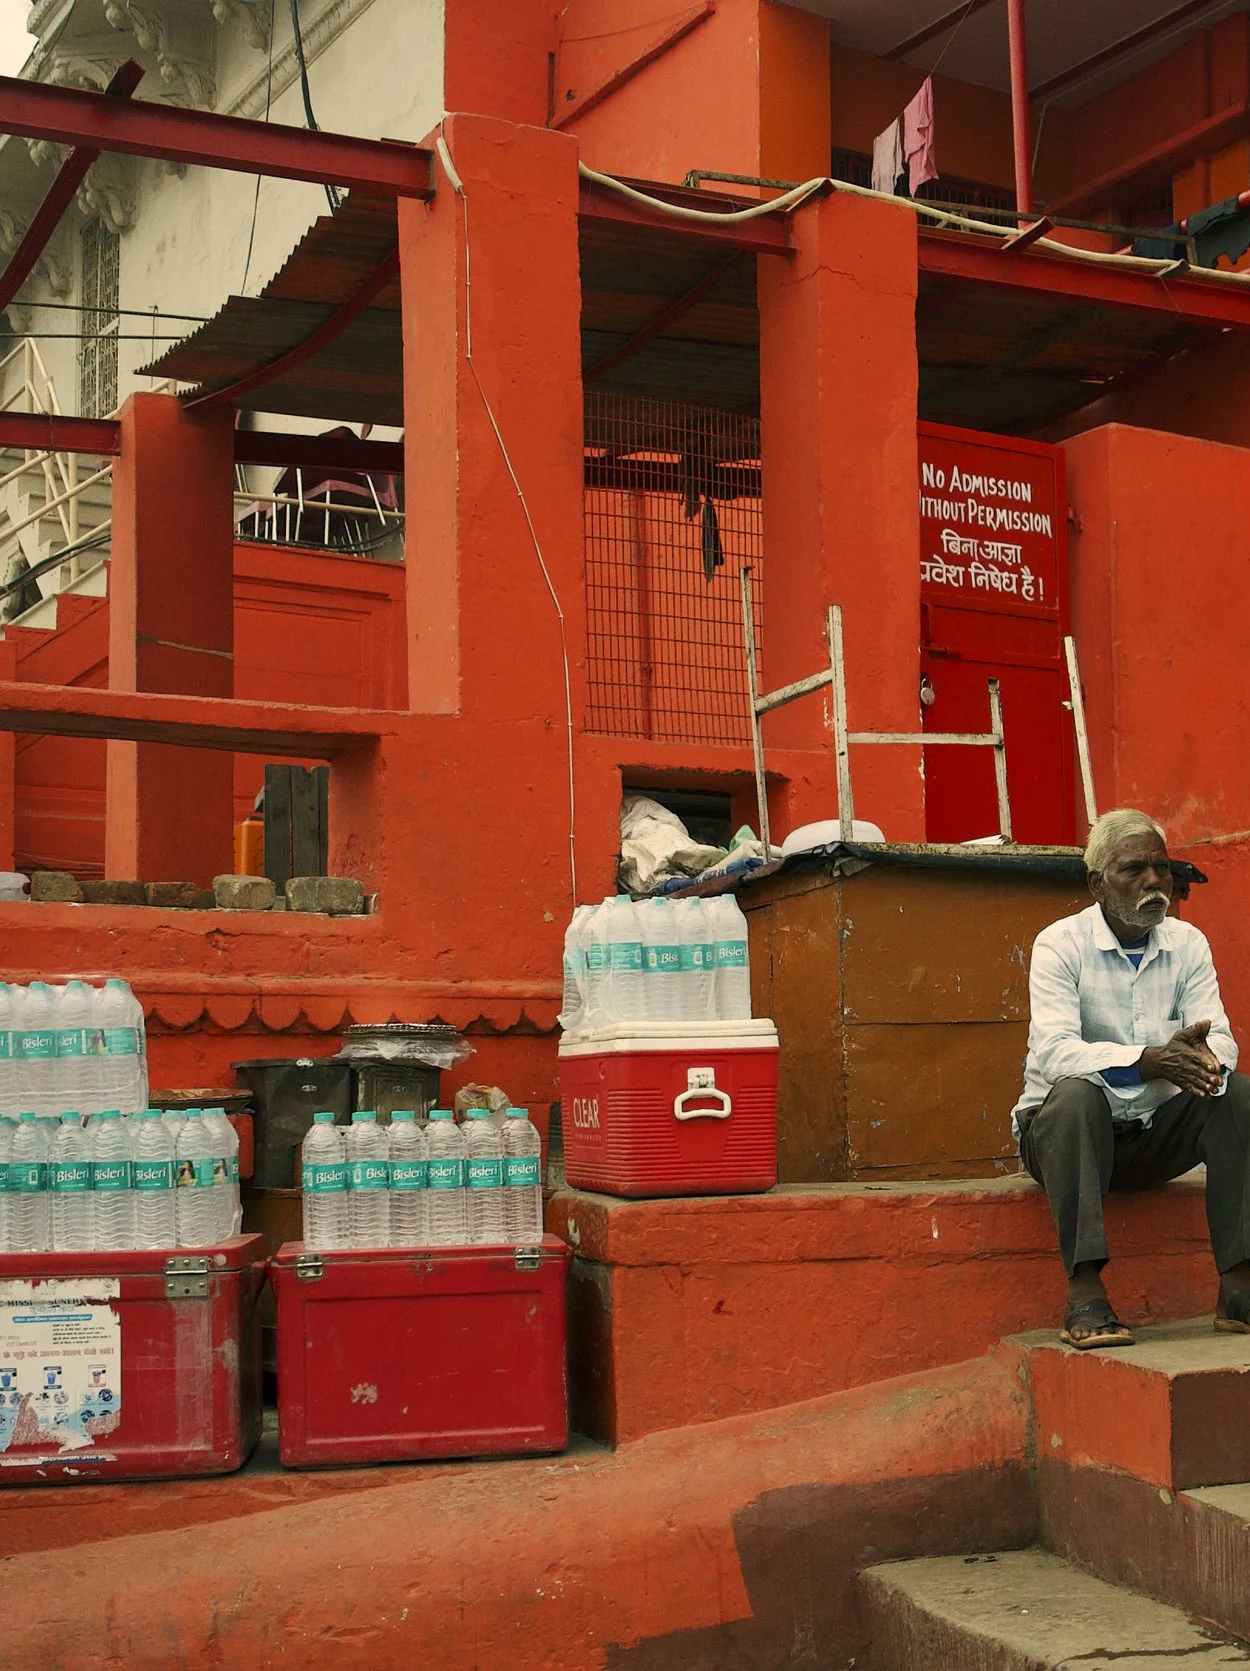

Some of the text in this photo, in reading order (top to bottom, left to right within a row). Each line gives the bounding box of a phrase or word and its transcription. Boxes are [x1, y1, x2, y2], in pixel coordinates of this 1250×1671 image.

[949, 465, 1032, 503] ADMISSION
[919, 489, 1053, 538] ITHOUT PERMISSION
[941, 528, 978, 562] बिना
[968, 562, 1019, 594] निषेध
[573, 1097, 600, 1128] CLEAR
[57, 1167, 90, 1182] Bisleri
[94, 1167, 125, 1181] Bisleri
[393, 1167, 423, 1180] Bisleri
[469, 1165, 497, 1178] Bisleri
[508, 1162, 537, 1176] Bisleri
